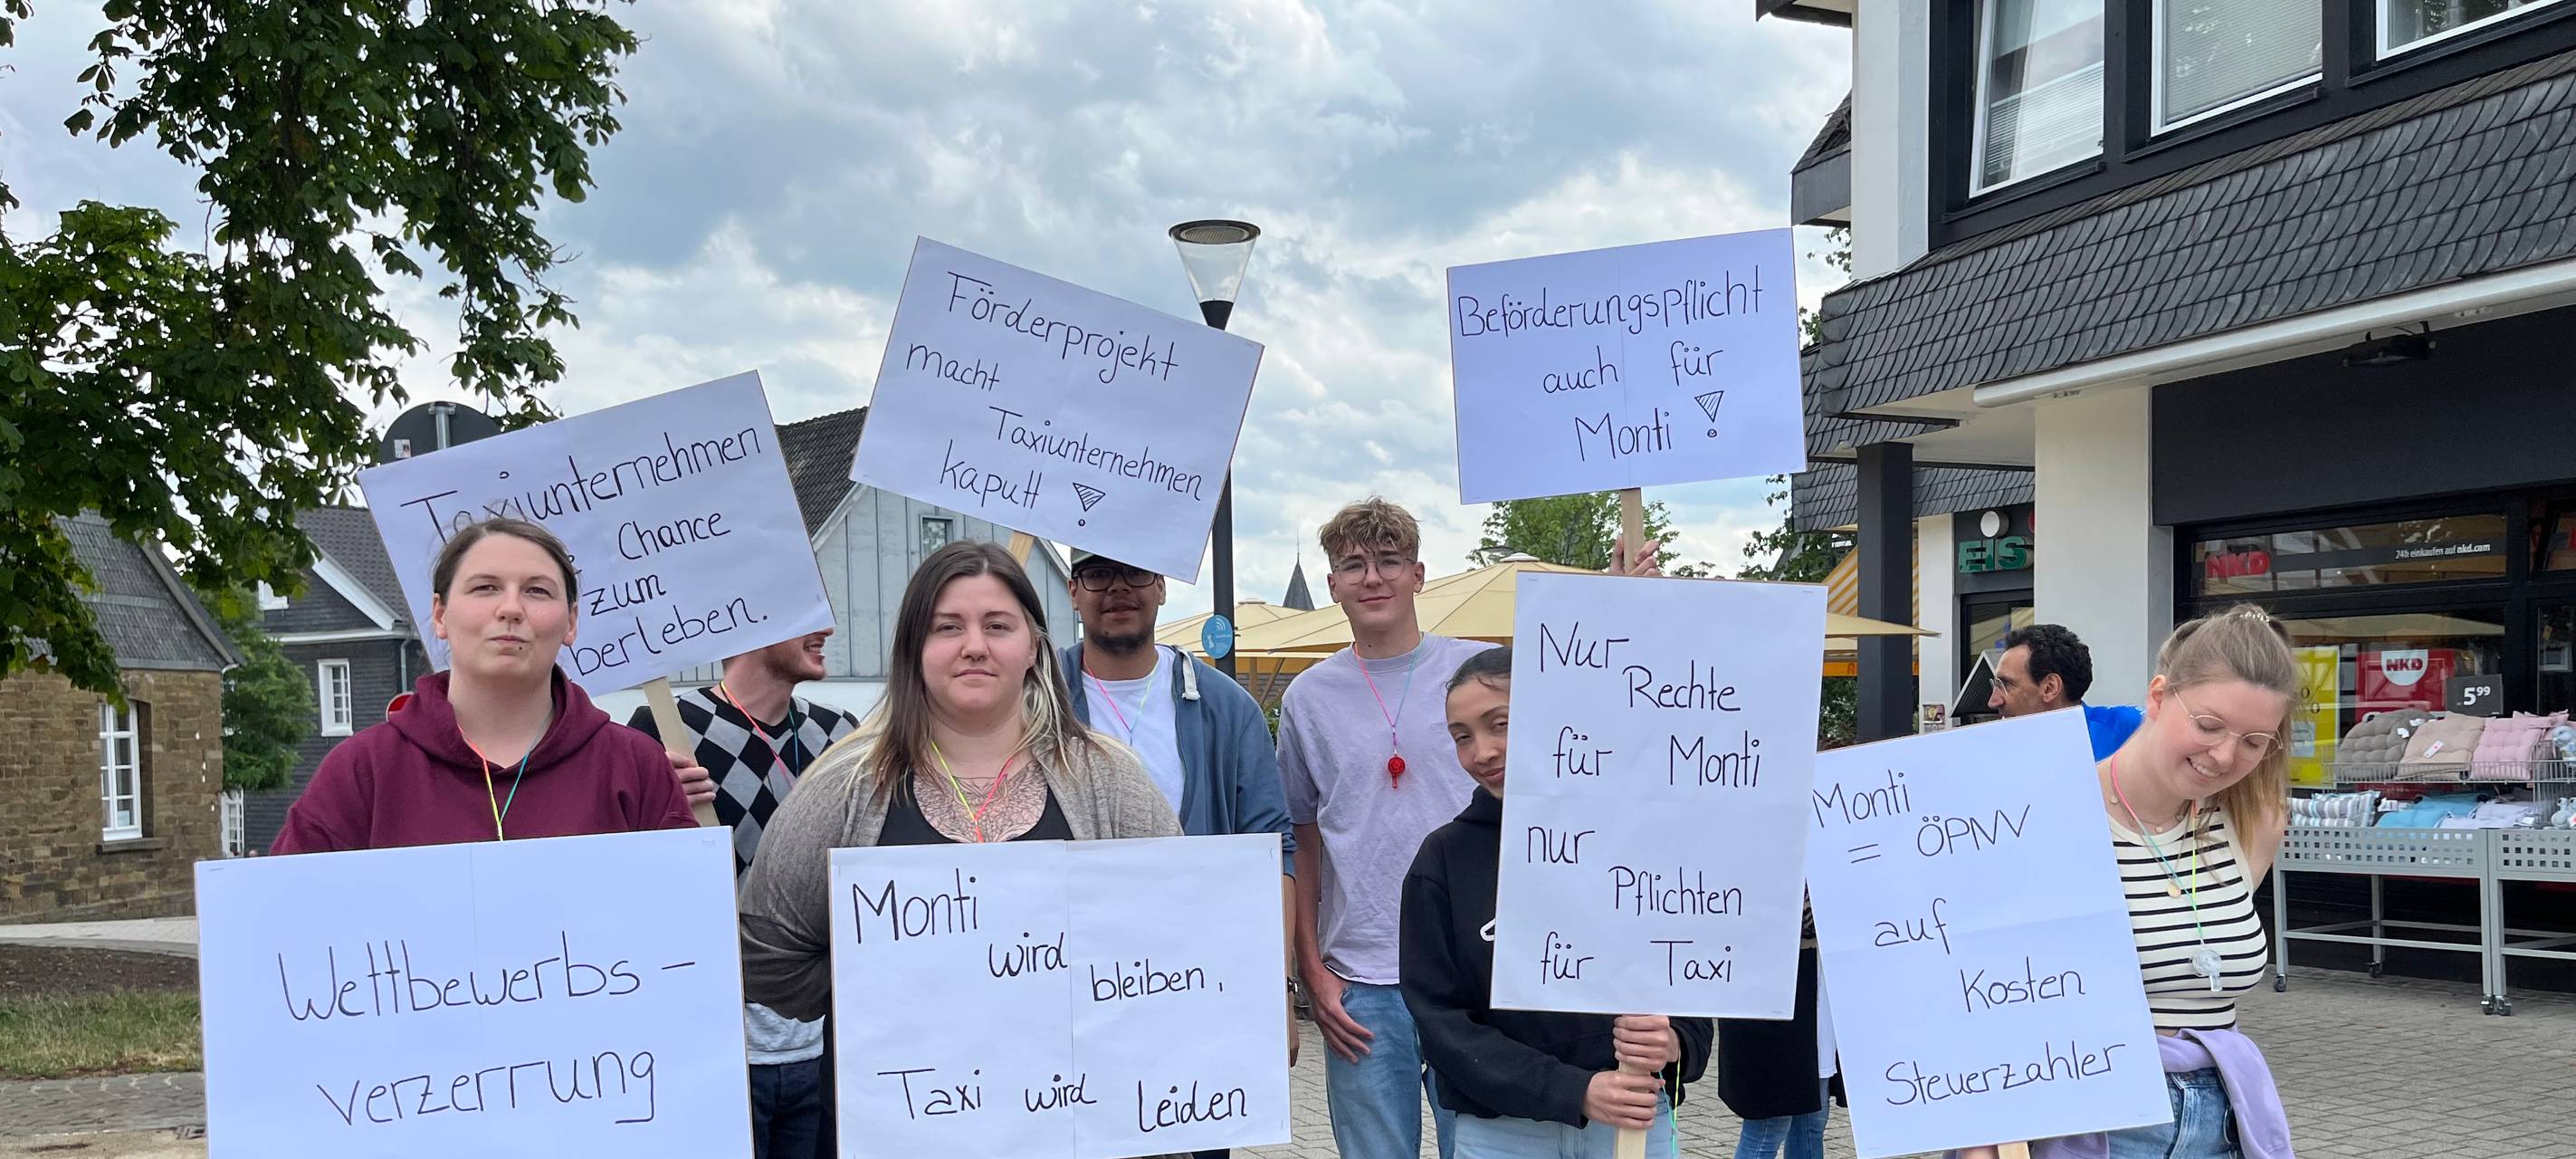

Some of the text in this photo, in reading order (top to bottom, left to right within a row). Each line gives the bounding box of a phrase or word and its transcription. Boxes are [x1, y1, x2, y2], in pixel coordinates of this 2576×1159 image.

[947, 271, 1179, 384] Förderprojekt
[1457, 264, 1763, 338] Beförderungspflicht
[905, 343, 1000, 392] macht
[1542, 340, 1724, 394] auch für
[988, 406, 1203, 502] Taxiunternehmen
[1574, 407, 1673, 463] Monti
[940, 439, 1043, 510] kaputt
[617, 510, 731, 560] Chance
[1958, 535, 2033, 573] EIS
[2205, 551, 2271, 579] NKD
[582, 574, 667, 617] zum
[568, 598, 768, 677] berleben.
[1540, 621, 1630, 673] Nur
[1622, 660, 1741, 712] Rechte
[2386, 658, 2424, 672] NKD
[1552, 725, 1760, 788] für Monti
[1812, 769, 1911, 829] Monti
[1527, 826, 1596, 865] nur
[1916, 804, 2031, 857] ÖPNV
[852, 867, 978, 944] Monti
[1608, 866, 1743, 917] Pflichten
[1874, 897, 1951, 955] auf
[987, 932, 1068, 979] wird
[1540, 931, 1732, 987] für Taxi
[1960, 956, 2086, 1013] Kosten
[877, 1068, 982, 1120] Taxi
[1024, 1072, 1097, 1111] wird
[1885, 1040, 2126, 1106] Steuerzahler
